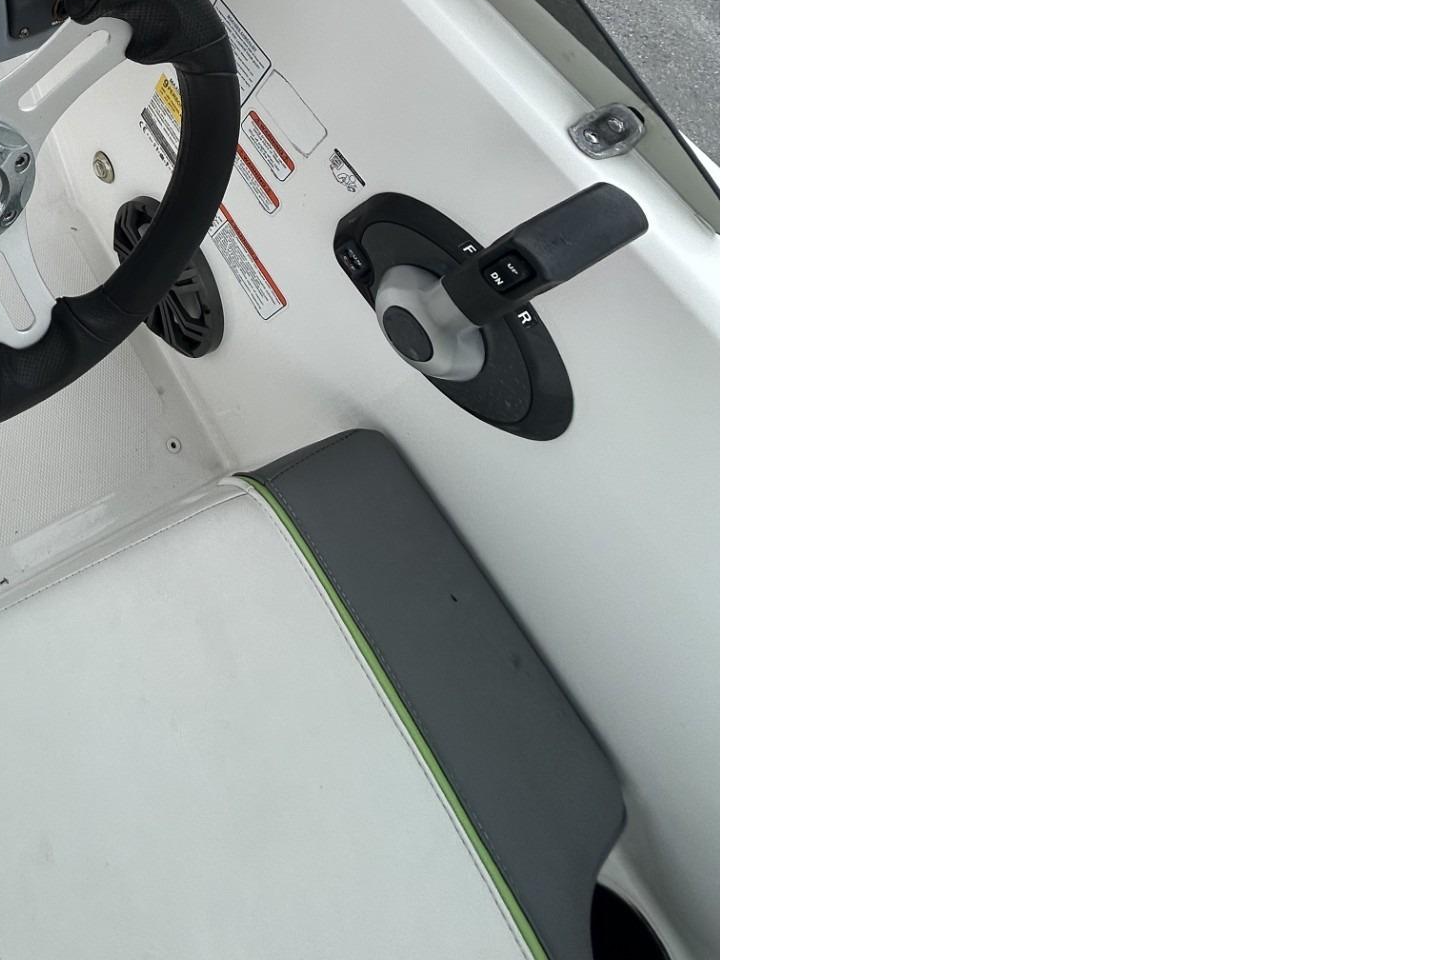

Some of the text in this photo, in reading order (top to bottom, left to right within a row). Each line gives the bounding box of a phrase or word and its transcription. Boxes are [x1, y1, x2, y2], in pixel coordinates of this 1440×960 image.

[462, 244, 477, 255] F
[490, 271, 504, 286] DN
[517, 310, 532, 325] R
